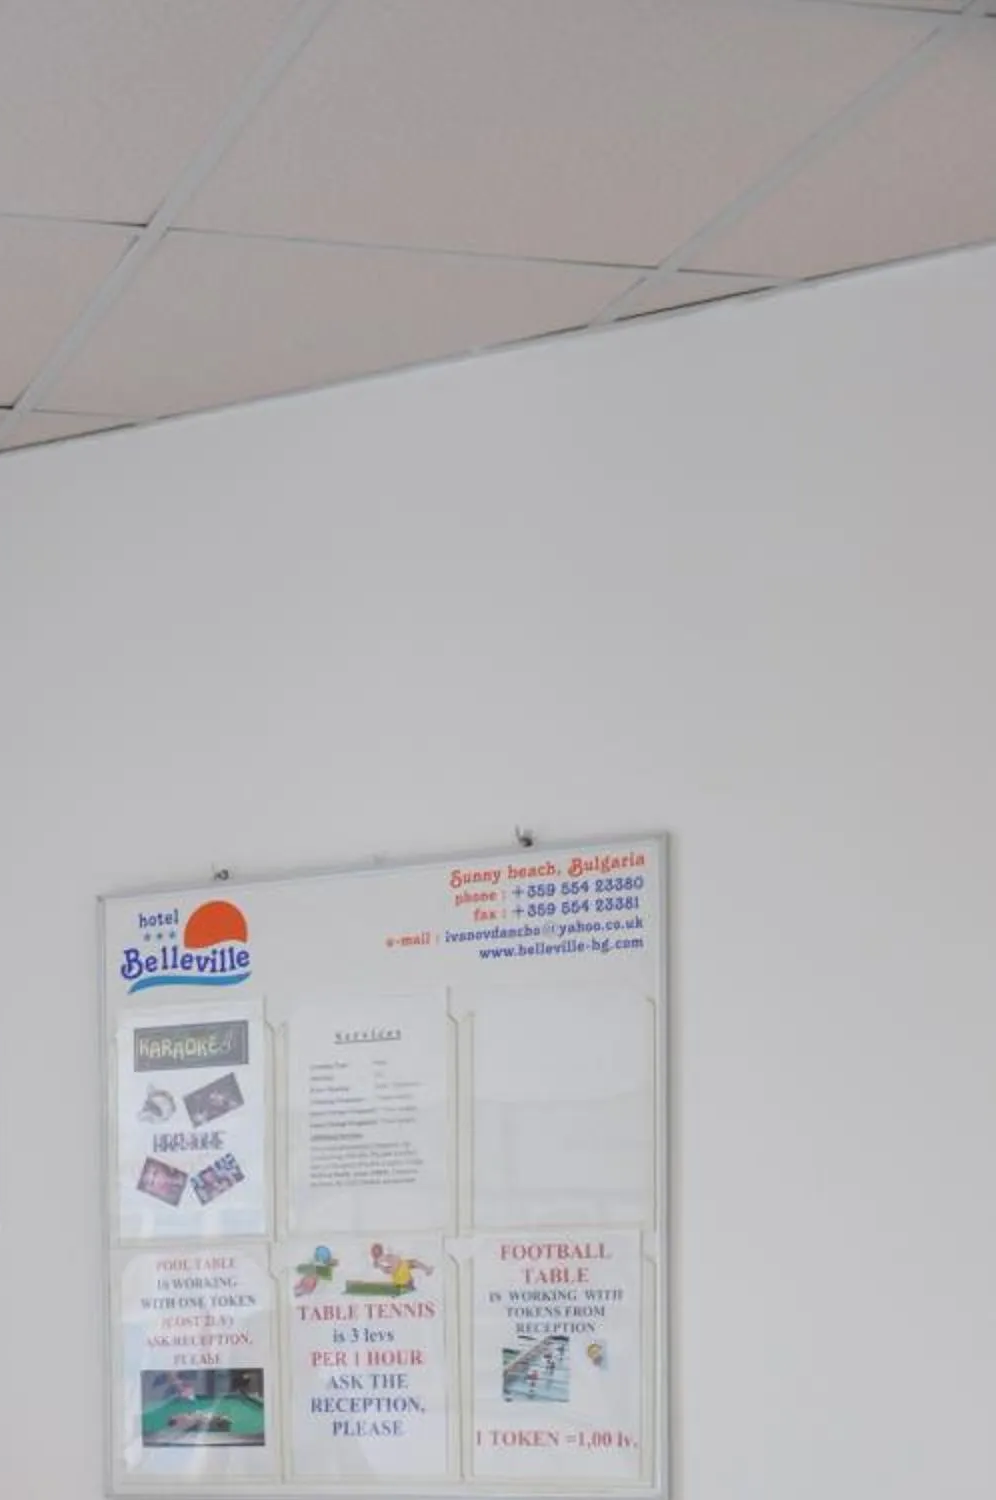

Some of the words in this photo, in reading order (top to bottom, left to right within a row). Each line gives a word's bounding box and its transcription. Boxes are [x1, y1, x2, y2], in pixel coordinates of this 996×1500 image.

[449, 868, 502, 888] Sunny
[567, 852, 646, 877] Bulgaria
[455, 890, 497, 906] phone
[560, 879, 589, 895] 554
[594, 876, 644, 893] 23380
[138, 908, 179, 928] hotel
[473, 908, 497, 921] fax
[560, 899, 589, 915] 554
[594, 897, 640, 913] 23381
[385, 931, 431, 948] e-mail
[479, 936, 644, 960] www.belleville-bg.com
[121, 945, 250, 979] Belleville
[500, 1242, 613, 1261] FOOTBALL
[522, 1267, 590, 1284] TABLE
[209, 1295, 256, 1308] TOKEN
[508, 1289, 577, 1302] WORKING
[584, 1288, 623, 1301] WITH
[296, 1304, 359, 1321] TABLE
[364, 1302, 436, 1319] TENNIS
[506, 1306, 562, 1318] TOKENS
[564, 1305, 606, 1317] FROM
[332, 1328, 346, 1343] is
[350, 1328, 360, 1343] 3
[363, 1327, 395, 1343] levs
[515, 1321, 595, 1334] RECEPTION
[311, 1351, 348, 1367] PER
[367, 1349, 424, 1366] HOUR
[330, 1375, 364, 1389] ASK
[370, 1373, 409, 1389] THE
[332, 1420, 404, 1437] PLEASE
[489, 1429, 560, 1447] TOKEN
